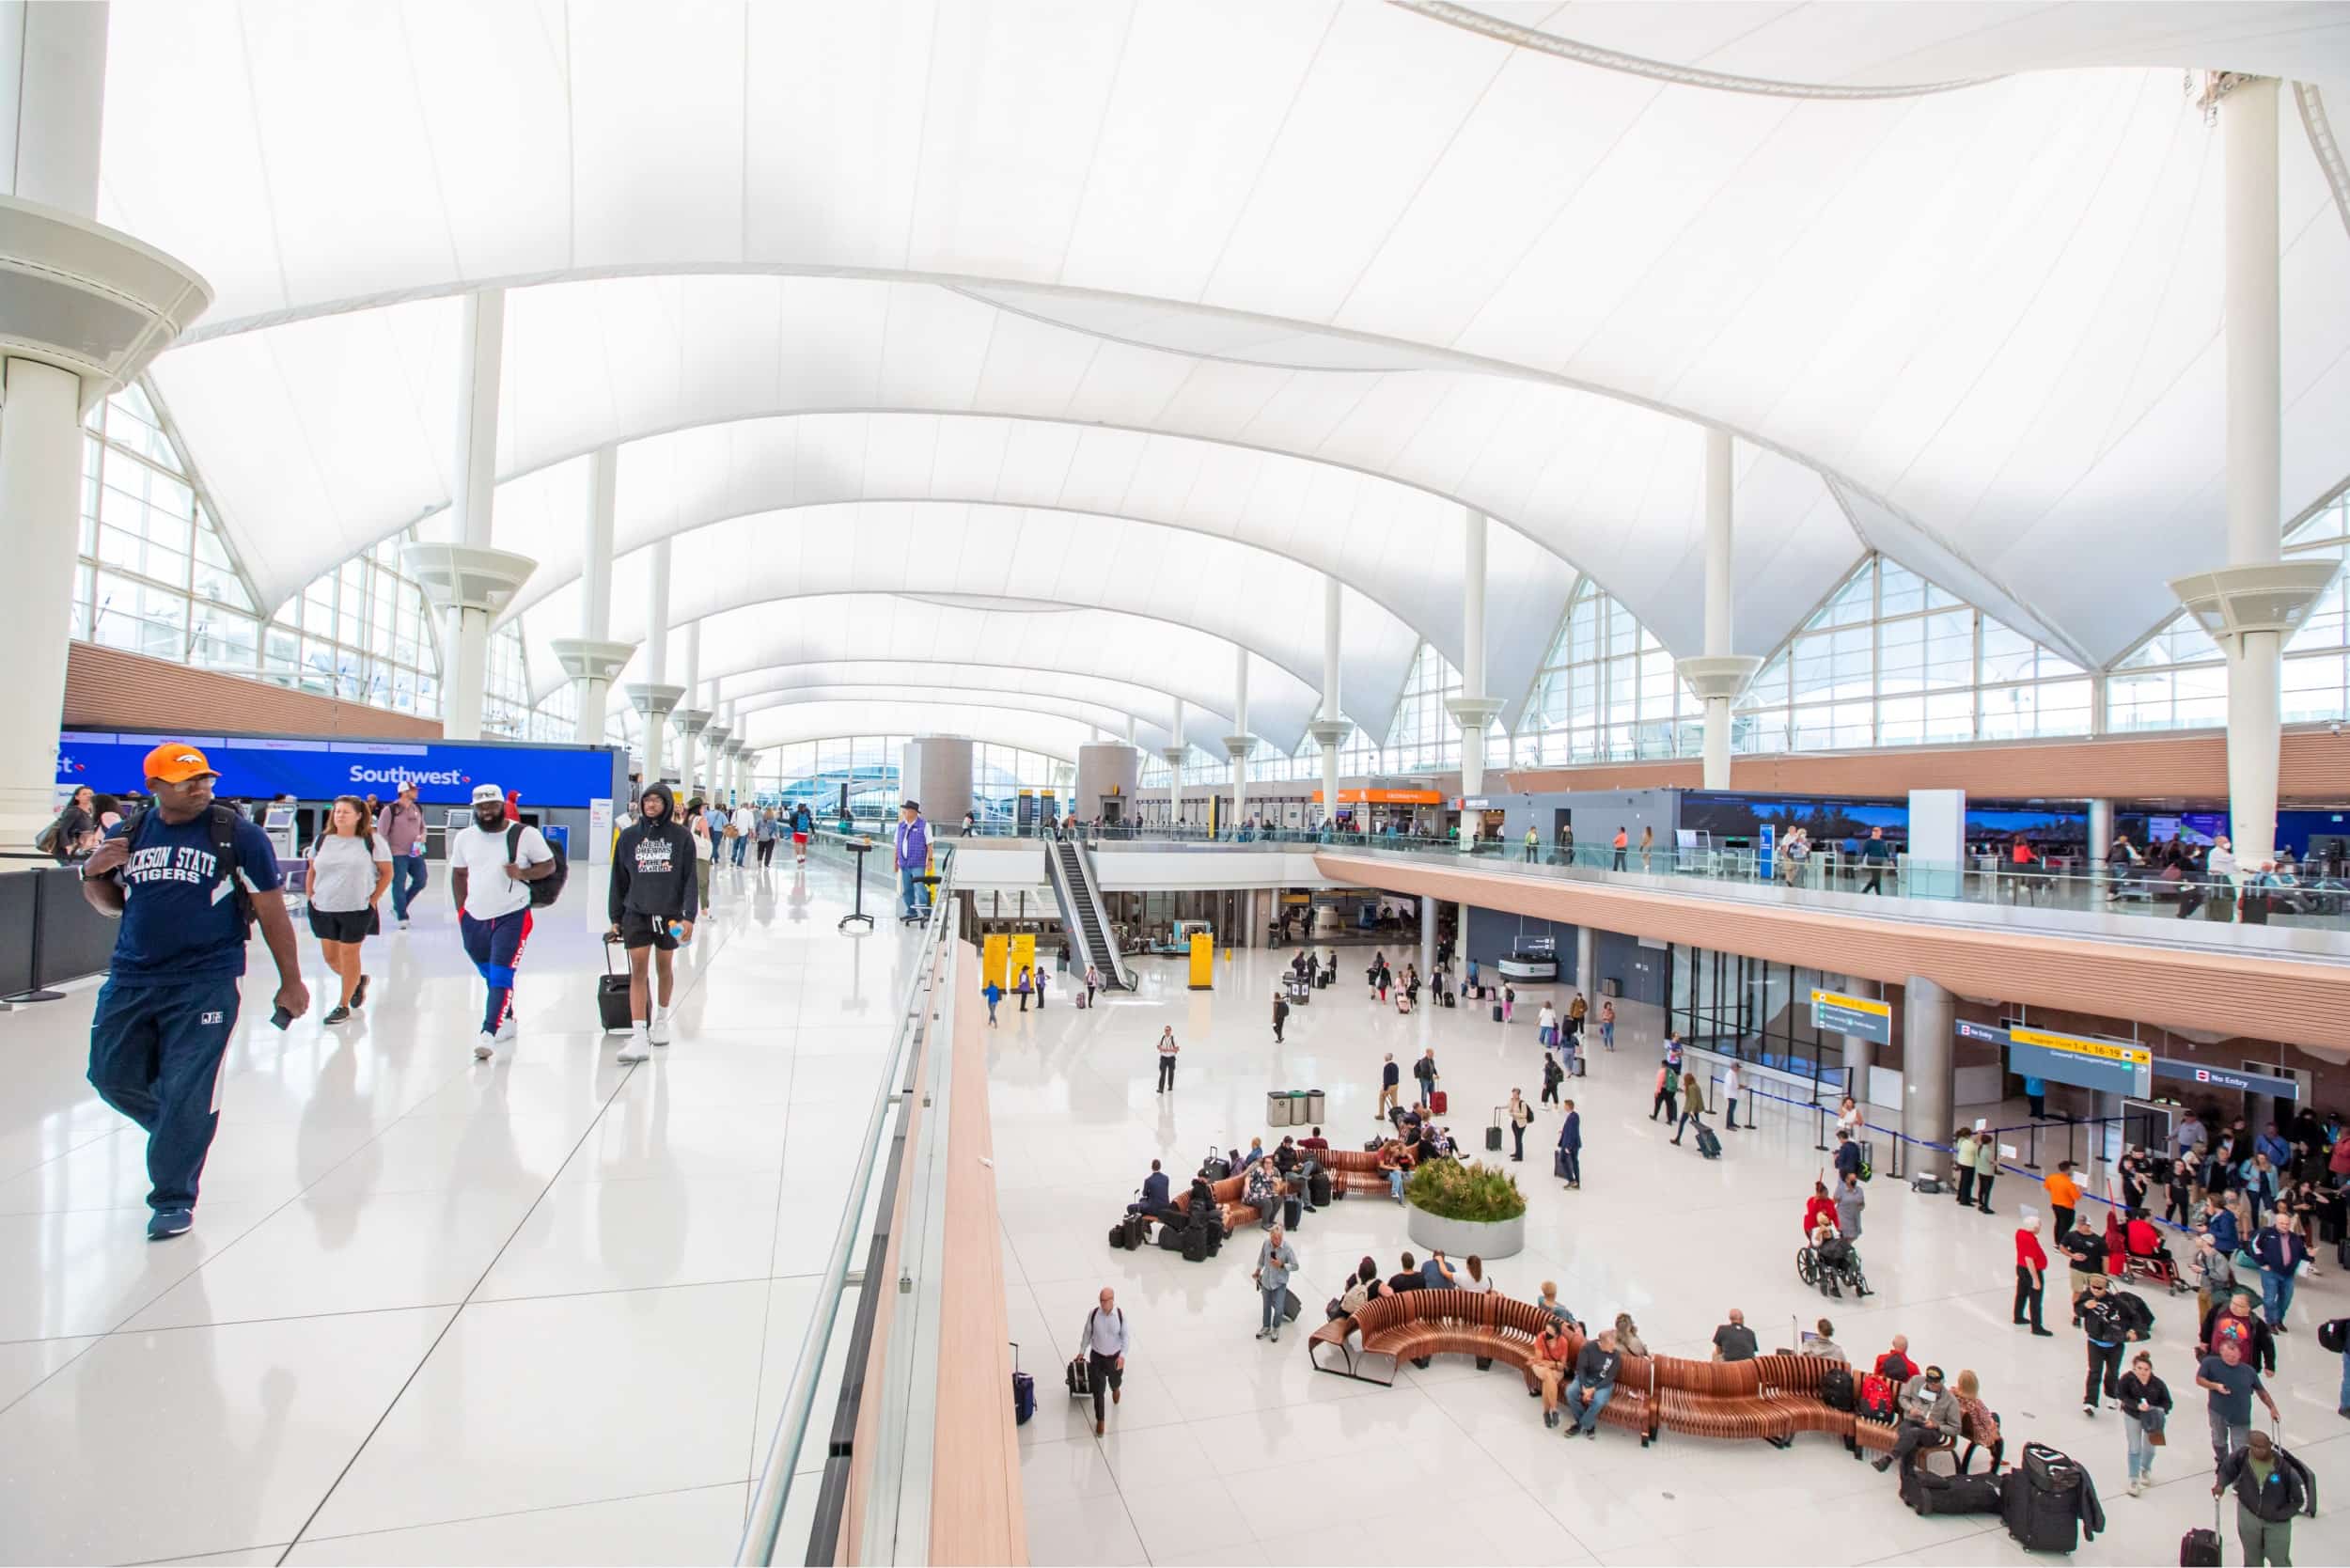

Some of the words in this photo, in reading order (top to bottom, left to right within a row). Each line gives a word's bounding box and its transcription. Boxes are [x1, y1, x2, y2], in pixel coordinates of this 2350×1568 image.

[350, 765, 461, 785] Southwest
[176, 846, 217, 878] STATE
[132, 868, 201, 884] TIGERS
[2094, 1045, 2122, 1058] 16-19
[2211, 1074, 2224, 1083] No
[2225, 1076, 2249, 1089] Entry
